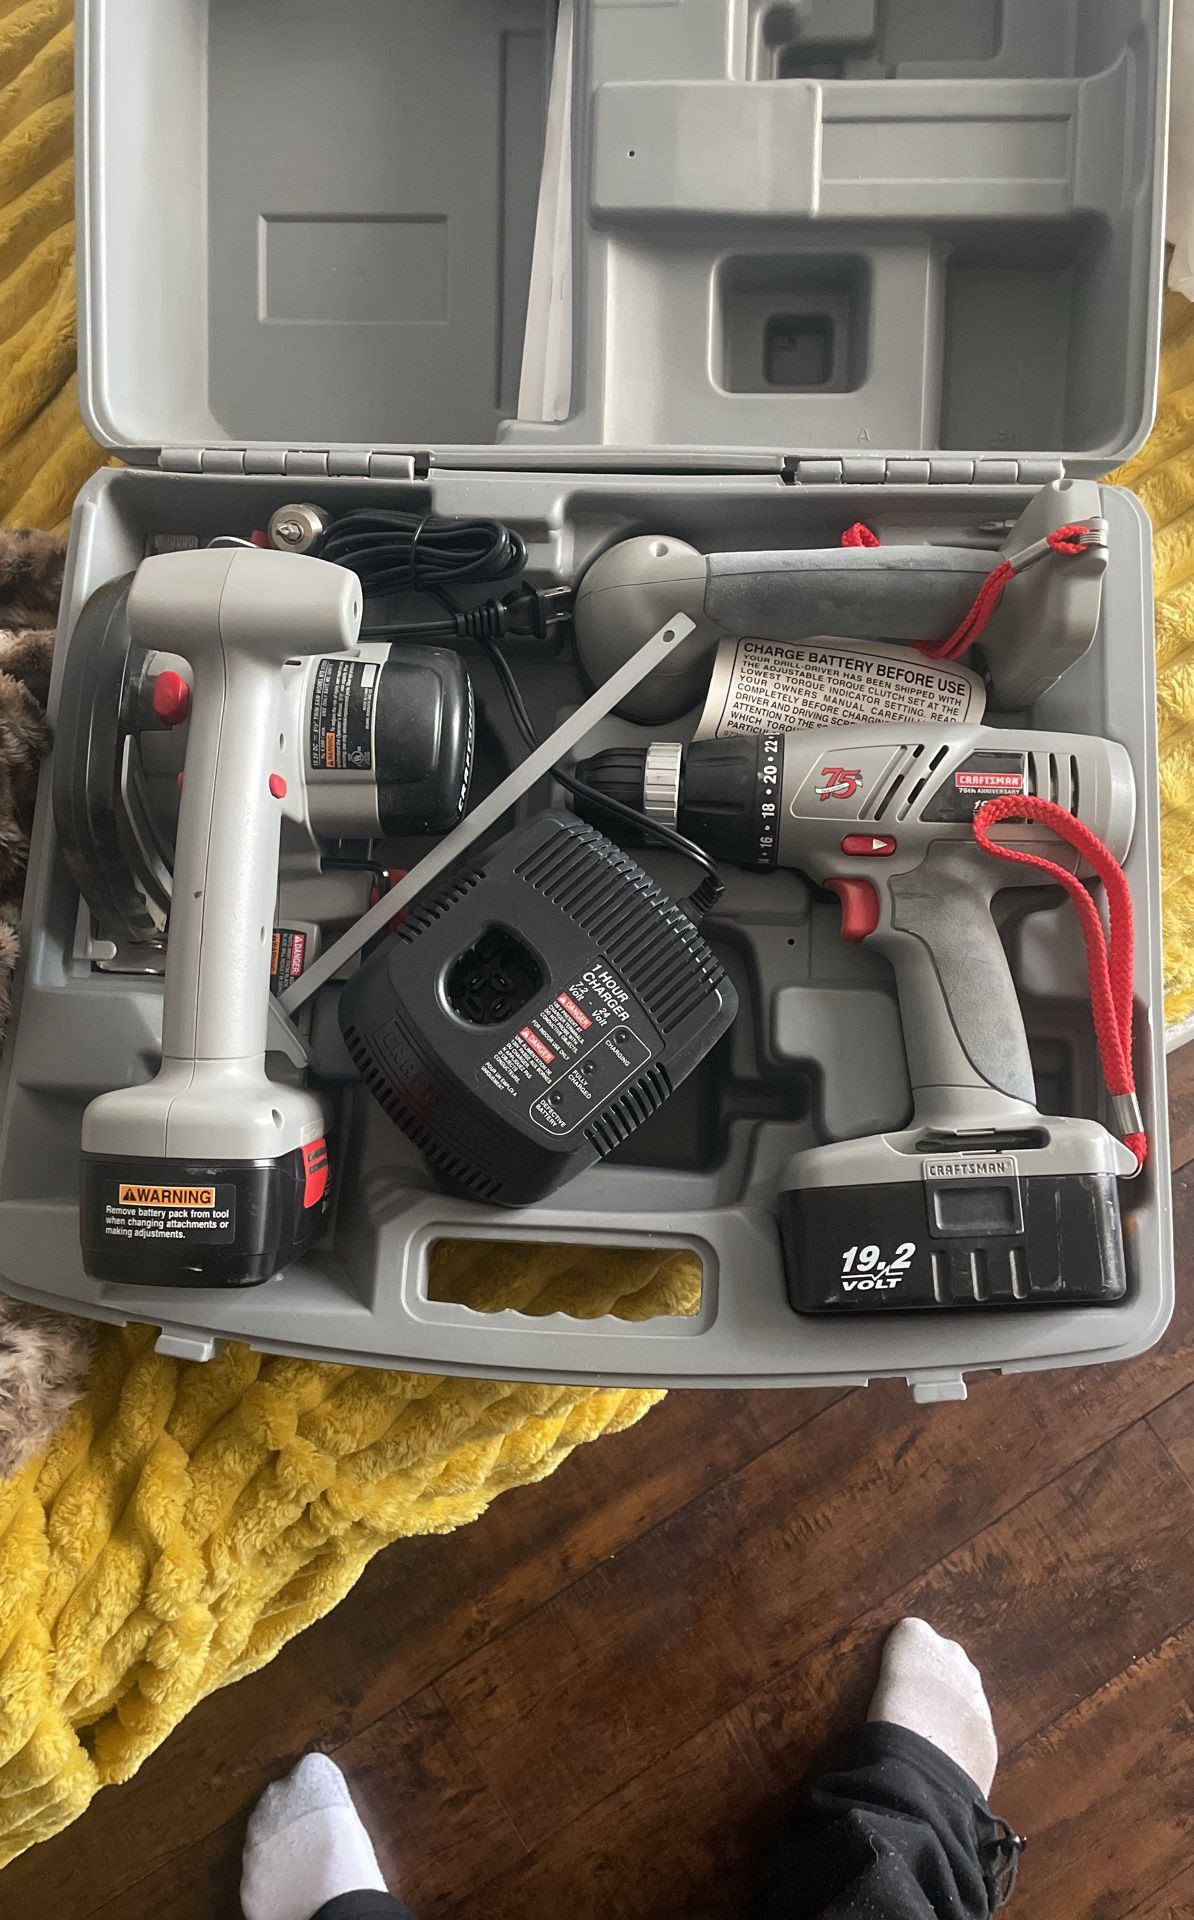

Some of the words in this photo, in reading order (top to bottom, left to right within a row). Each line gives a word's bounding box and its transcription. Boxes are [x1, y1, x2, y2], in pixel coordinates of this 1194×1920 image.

[744, 643, 805, 660] CHARGE
[809, 652, 873, 673] BATTERY
[877, 664, 934, 688] BEFORE
[938, 679, 965, 696] USE
[744, 654, 770, 663] YOUR
[774, 660, 839, 676] DRILL-DRIVER
[843, 673, 862, 682] HAS
[866, 677, 891, 688] BEEN
[895, 684, 934, 699] SHIPPED
[939, 694, 961, 706] WITH
[738, 683, 799, 704] COMPLETELY
[802, 699, 839, 715] BEFORE
[740, 675, 767, 686] YOUR
[774, 682, 817, 699] OWNERS
[824, 694, 864, 711] MANUAL
[741, 668, 781, 680] LOWEST
[786, 676, 825, 691] TORQUE
[829, 687, 880, 705] INDICATOR
[884, 701, 926, 718] SETTING.
[763, 664, 824, 682] ADJUSTABLE
[827, 677, 864, 691] TORQUE
[868, 687, 904, 701] CLUTCH
[908, 696, 924, 706] SET
[942, 705, 959, 716] THE
[731, 711, 762, 725] WHICH
[733, 701, 782, 720] ATTENTION
[784, 715, 795, 723] TO
[798, 718, 814, 728] THE
[736, 692, 769, 706] DRIVER
[771, 702, 790, 712] AND
[793, 706, 829, 722] DRIVING
[765, 740, 778, 752] 22
[763, 766, 777, 784] 20
[820, 767, 861, 801] 75
[960, 775, 1019, 785] CRAFTSMAN
[762, 803, 775, 818] 18
[760, 836, 773, 848] 16
[592, 963, 602, 971] 1
[597, 971, 628, 1002] HOUR
[569, 984, 584, 1001] Volt
[591, 1009, 607, 1026] Volt
[575, 981, 588, 994] 7.2
[598, 1007, 610, 1017] 24
[582, 971, 629, 1021] CHARGER
[540, 1012, 562, 1036] CONDUCTIVE
[548, 1004, 565, 1023] CHARGER
[560, 1010, 577, 1027] PRESENT
[565, 1001, 588, 1026] DANGER
[531, 1019, 540, 1028] FOR
[539, 1027, 553, 1042] INDOOR
[551, 1041, 560, 1050] USE
[559, 1049, 569, 1060] ONLY
[549, 1014, 558, 1022] NOT
[556, 1022, 569, 1035] PROBE
[568, 1034, 578, 1045] WITH
[528, 1035, 551, 1060] DANGER
[605, 1039, 630, 1066] CHARGING
[481, 1065, 504, 1089] UNIQUEMENT
[485, 1061, 496, 1073] POUR
[500, 1078, 514, 1093] EMPLOI
[523, 1069, 531, 1078] PAS
[568, 1074, 591, 1098] CHARGED
[572, 1069, 588, 1085] FULLY
[535, 1103, 556, 1126] BATTERY
[540, 1099, 566, 1127] DEFECTIVE
[929, 1162, 1005, 1176] CRAFTSMAN
[137, 1188, 211, 1204] WARNING
[106, 1205, 135, 1216] Remove
[138, 1207, 165, 1219] battery
[169, 1209, 188, 1220] pack
[191, 1209, 210, 1218] from
[212, 1210, 229, 1219] tool
[106, 1217, 125, 1225] when
[128, 1218, 164, 1230] changing
[167, 1220, 217, 1229] attachments
[106, 1227, 132, 1238] making
[134, 1229, 185, 1239] adjustments.
[842, 1243, 916, 1272] 19.2
[842, 1277, 902, 1291] VOLT
